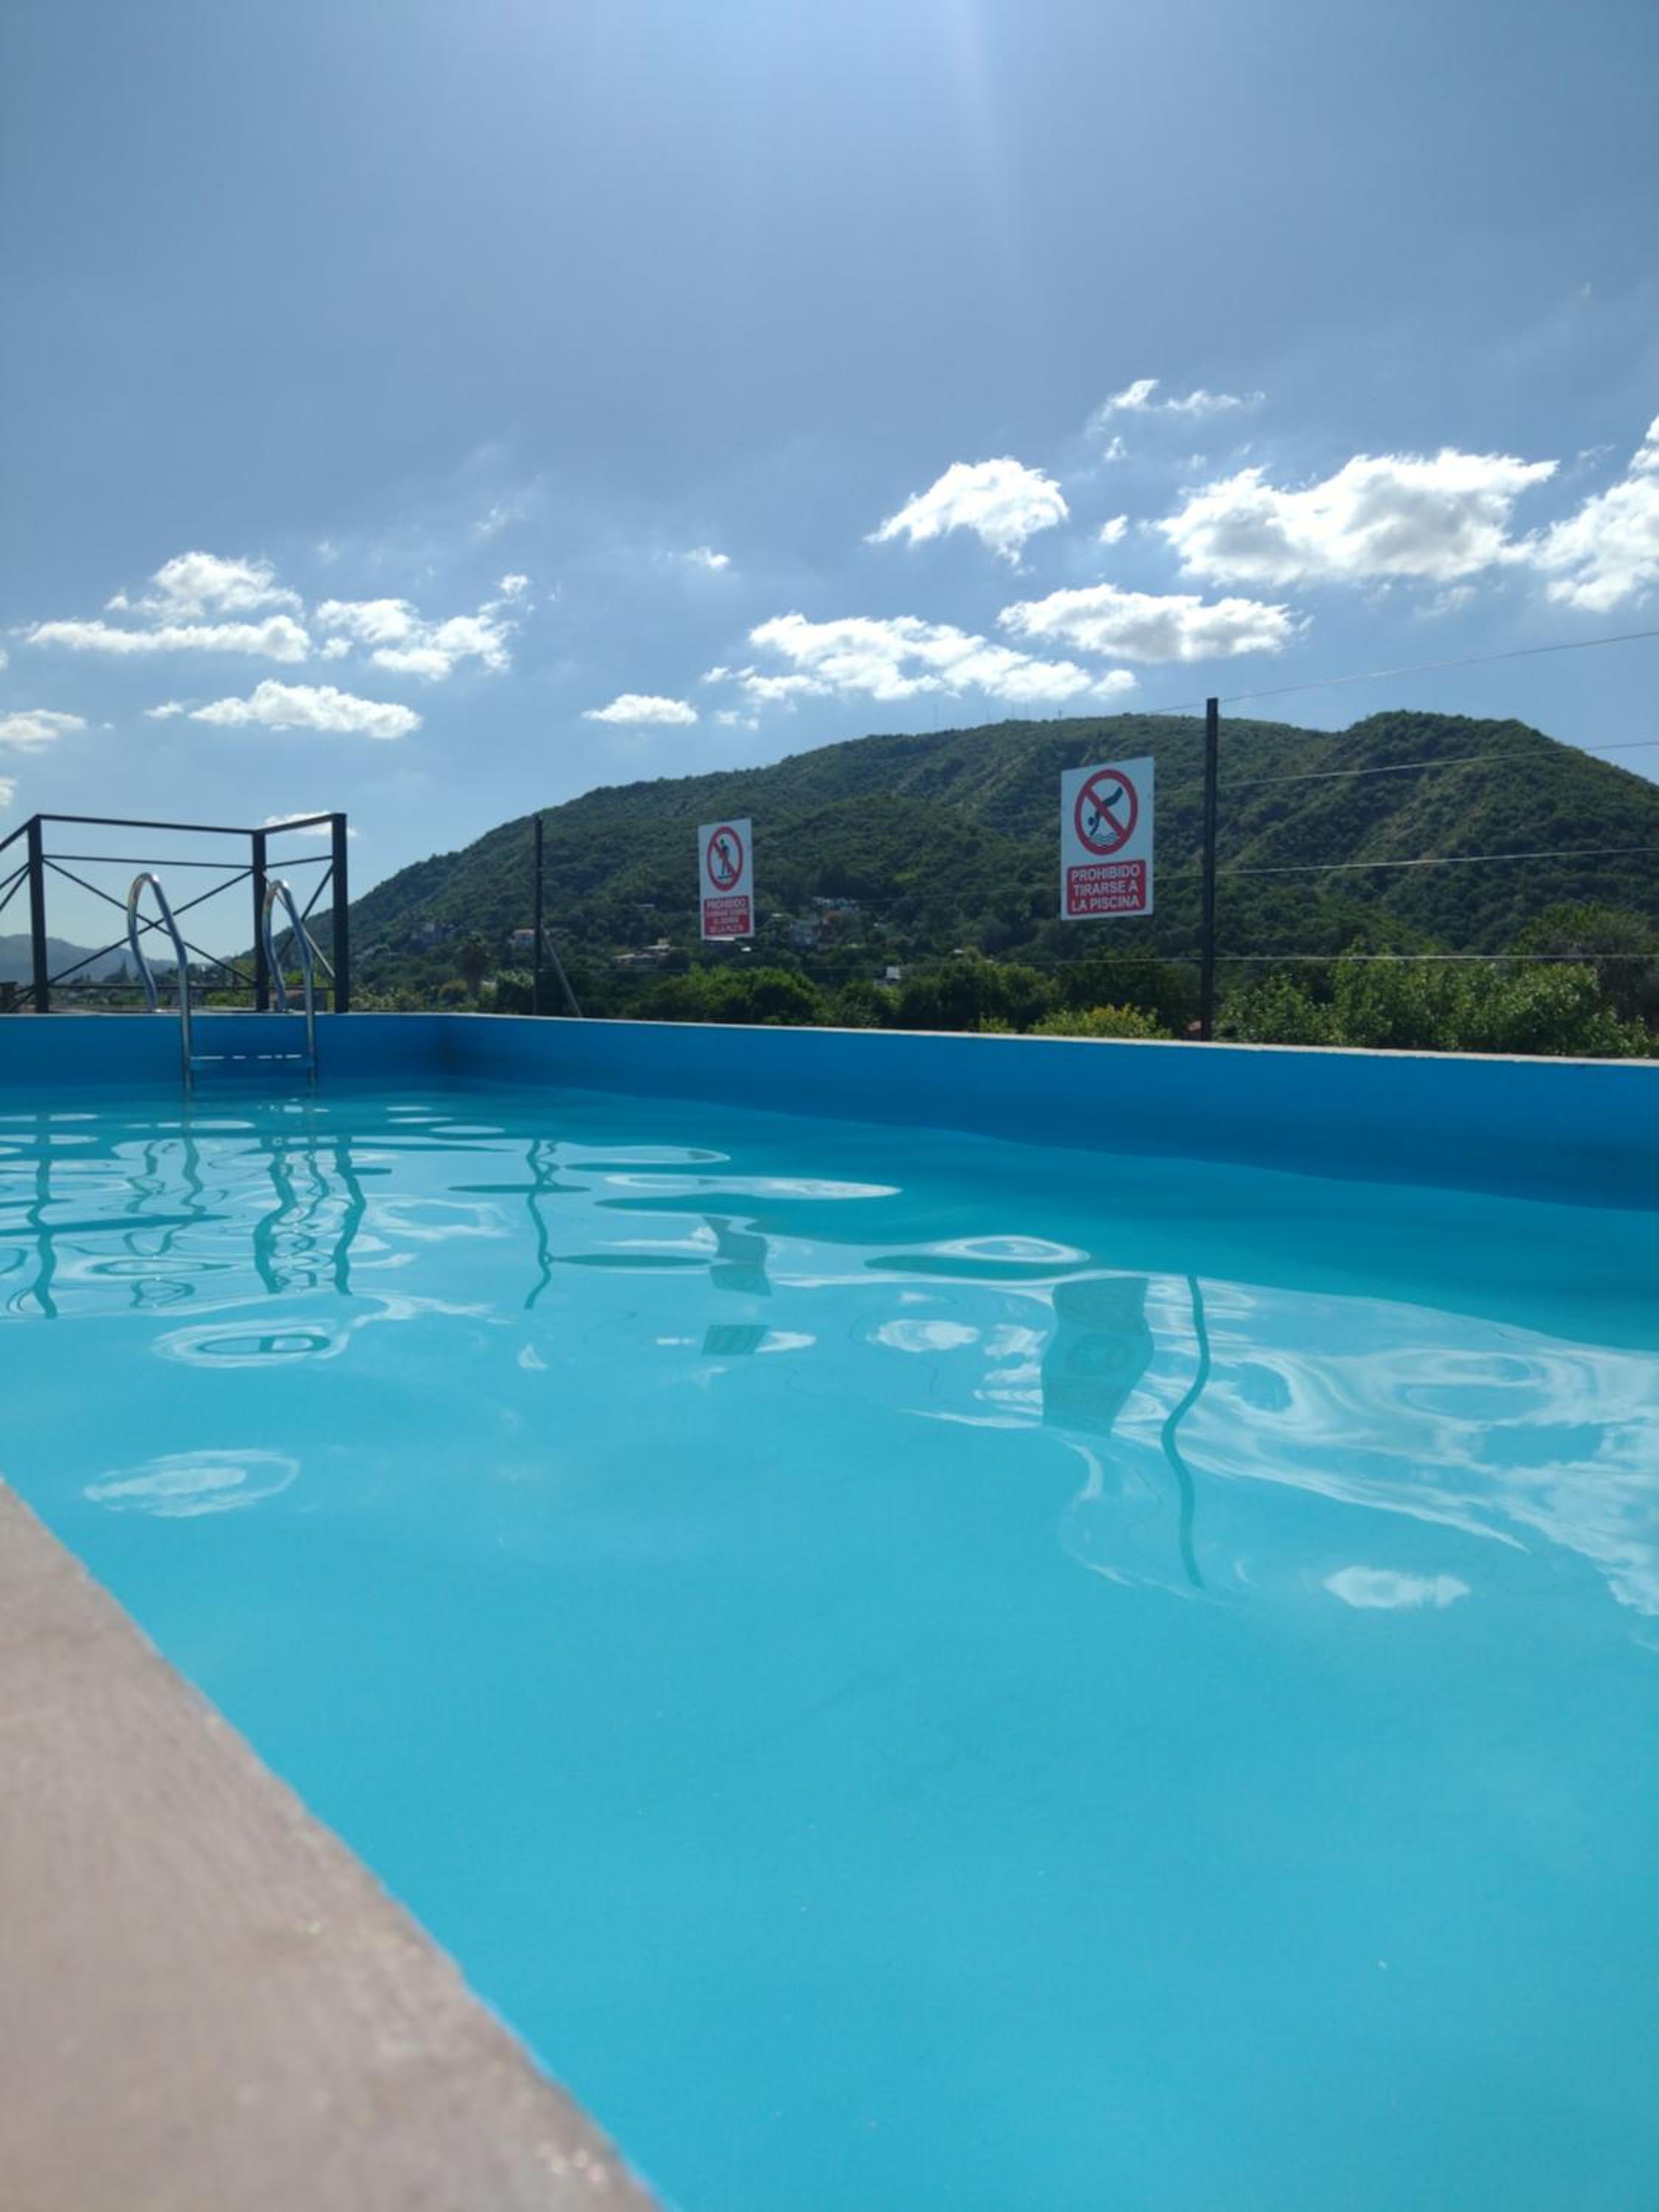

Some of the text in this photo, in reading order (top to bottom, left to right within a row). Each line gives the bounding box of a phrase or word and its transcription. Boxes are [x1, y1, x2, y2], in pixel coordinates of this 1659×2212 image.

[1071, 864, 1139, 881] PROHIBIDO
[1074, 879, 1139, 897] TIRARSE A
[1072, 894, 1140, 911] LA PISCINA
